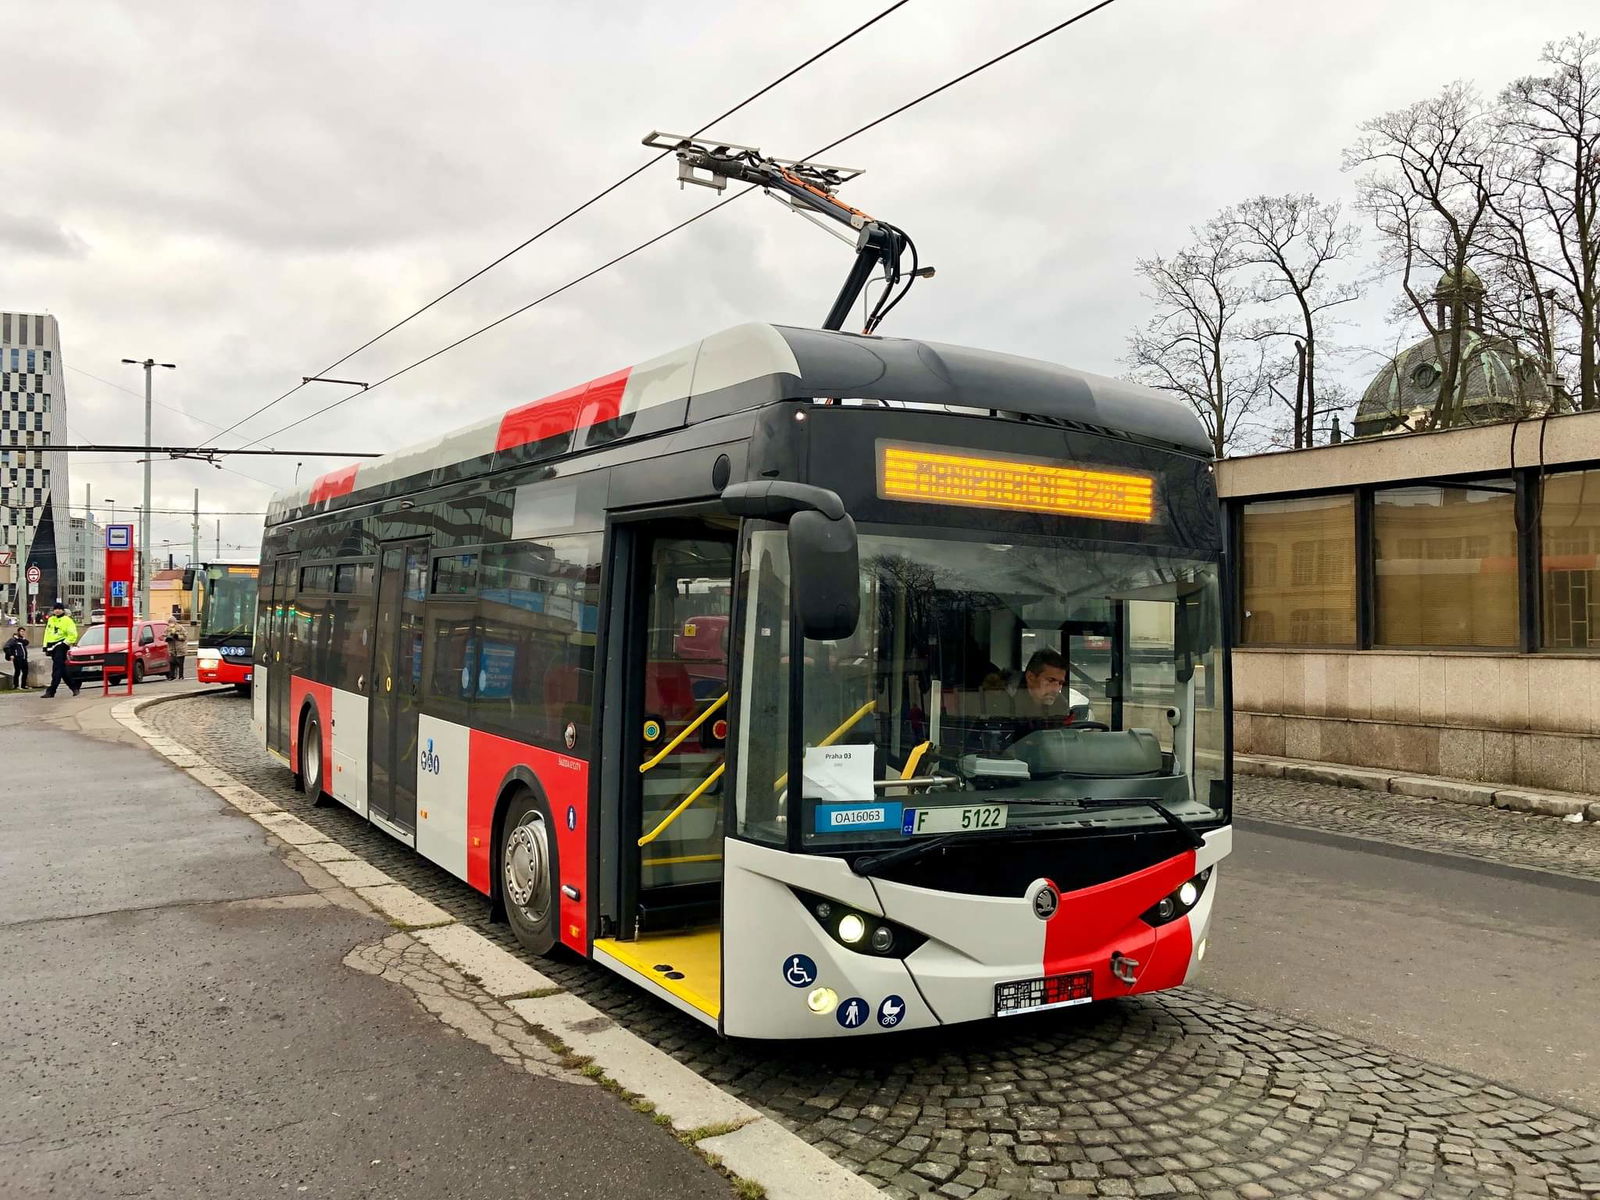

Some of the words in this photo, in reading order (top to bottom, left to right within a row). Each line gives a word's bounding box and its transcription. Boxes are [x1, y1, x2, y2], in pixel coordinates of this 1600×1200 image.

[835, 810, 881, 824] OA16063
[917, 811, 929, 832] F
[961, 807, 1001, 829] 5122
